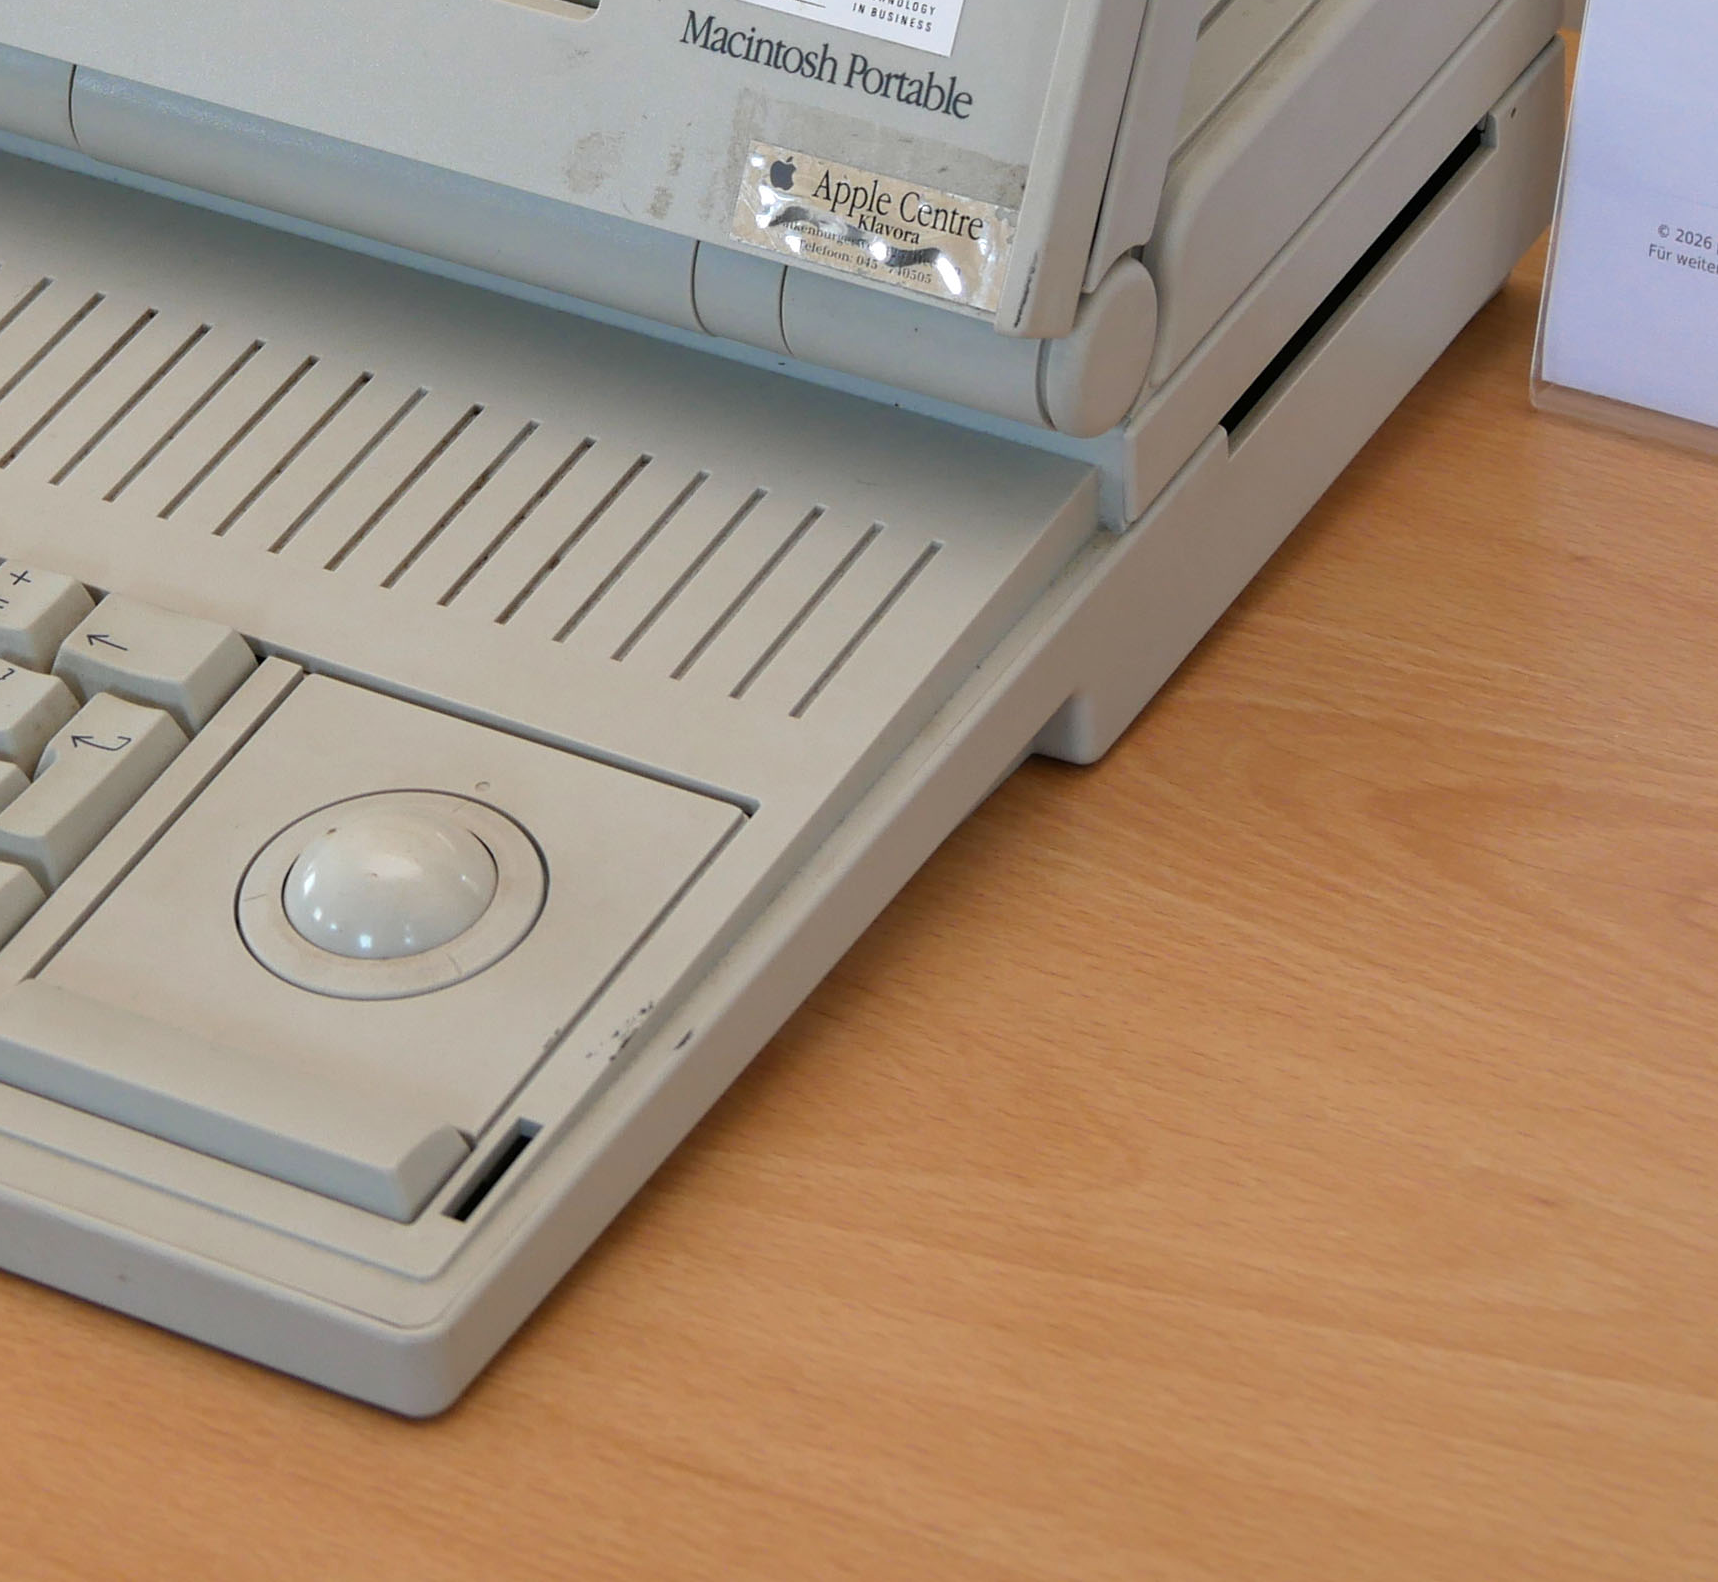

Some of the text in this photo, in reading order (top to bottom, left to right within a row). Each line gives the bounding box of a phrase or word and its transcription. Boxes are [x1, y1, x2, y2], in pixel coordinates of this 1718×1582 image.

[852, 3, 933, 32] IN BUSINESS
[680, 10, 973, 119] Macintosh Portable
[812, 170, 984, 240] Apple Centre
[858, 214, 921, 245] Klavora
[1675, 228, 1713, 250] 2026
[1649, 243, 1673, 261] Für
